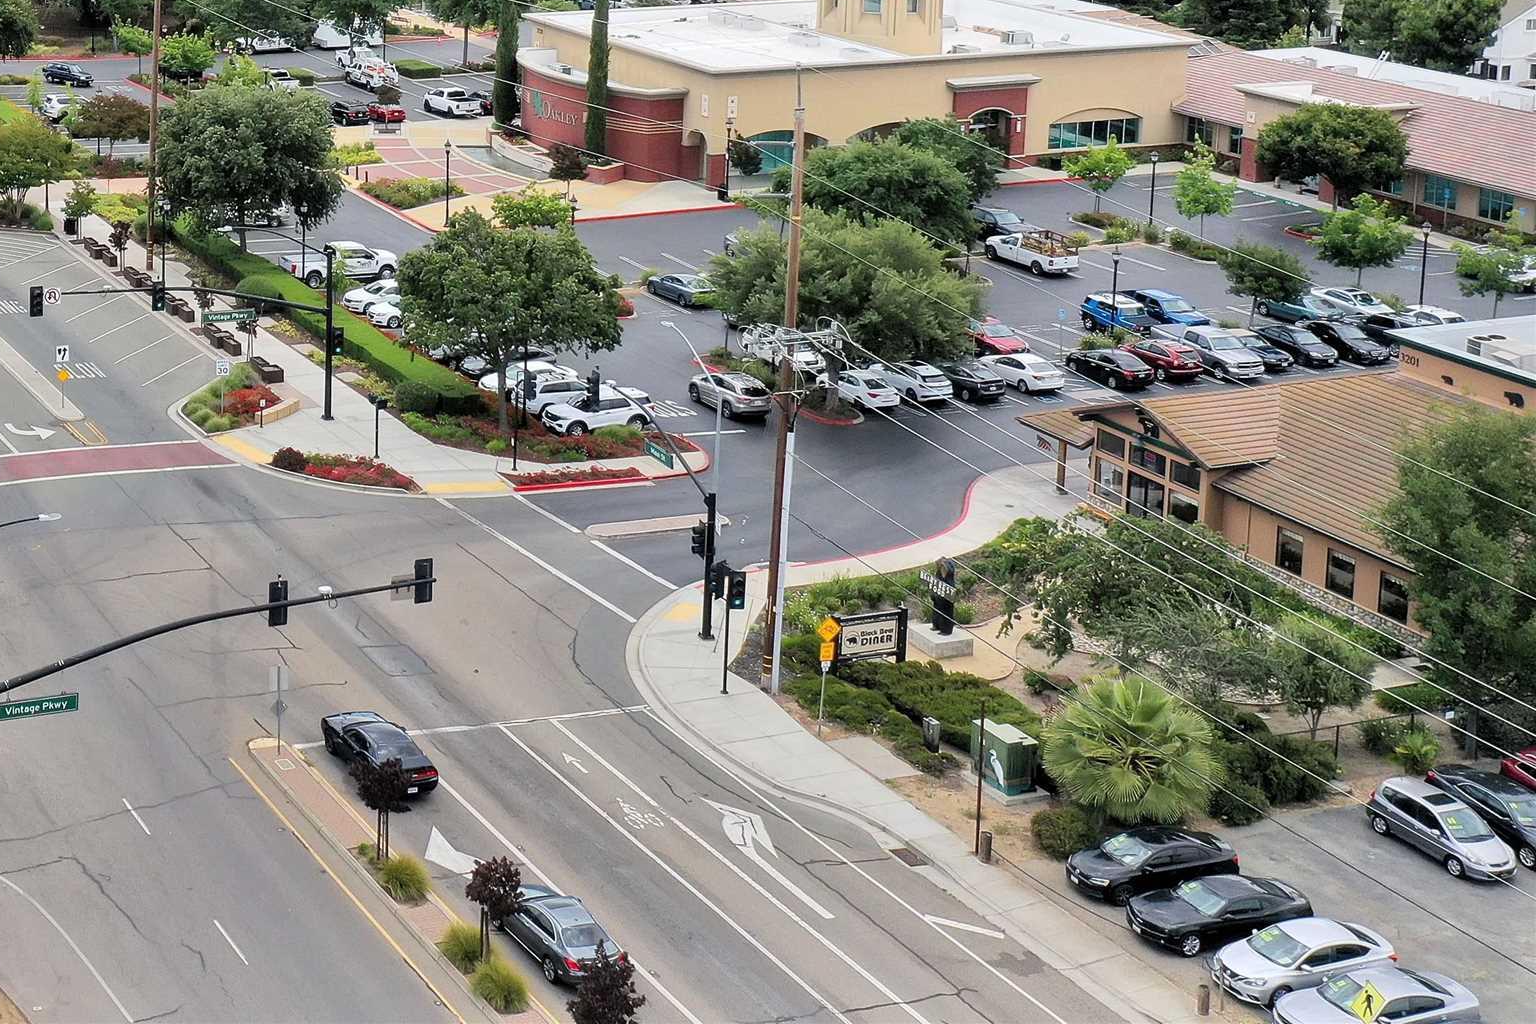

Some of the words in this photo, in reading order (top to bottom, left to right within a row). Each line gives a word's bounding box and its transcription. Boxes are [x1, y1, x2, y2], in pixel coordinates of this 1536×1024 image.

[217, 367, 229, 375] 30
[860, 634, 893, 647] DINER
[5, 704, 41, 715] Vintage
[42, 700, 69, 711] Pkwy
